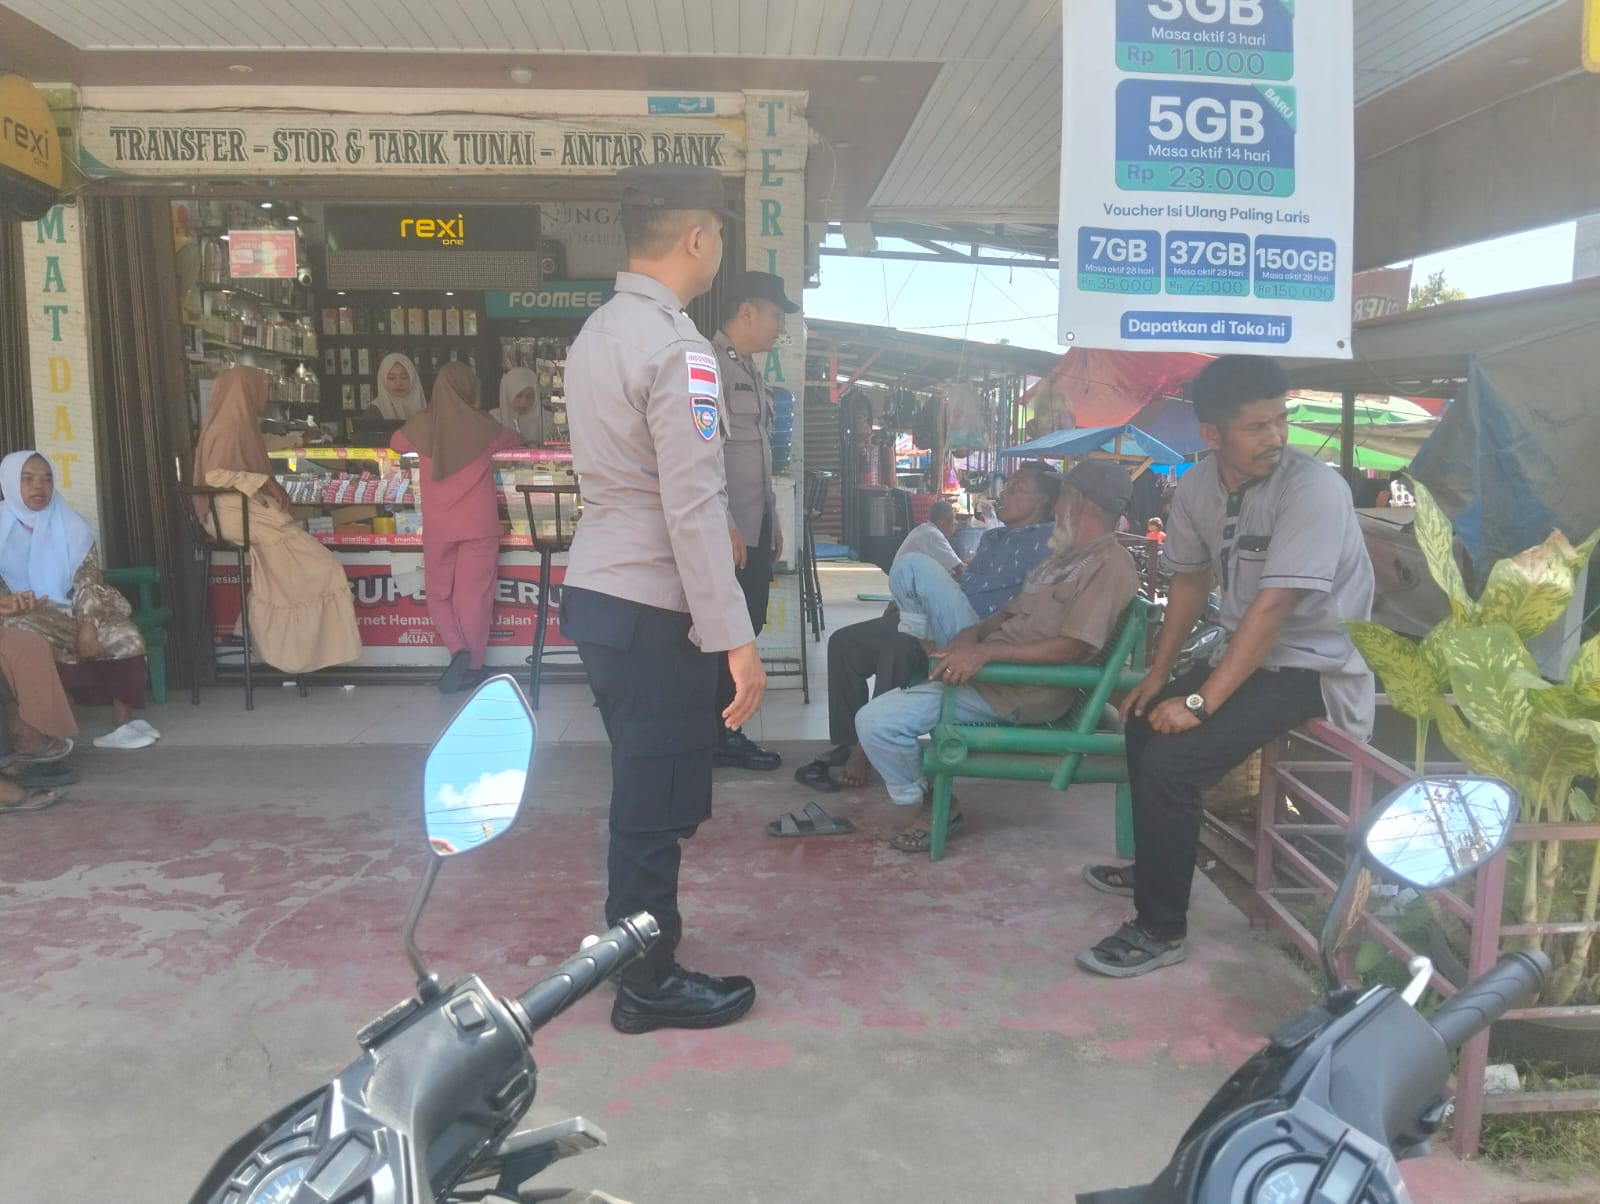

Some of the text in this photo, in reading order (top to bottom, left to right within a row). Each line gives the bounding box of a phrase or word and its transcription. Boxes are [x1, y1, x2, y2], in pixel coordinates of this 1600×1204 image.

[1151, 27, 1266, 46] Masa aktif 3 hari
[1127, 45, 1265, 75] Rp 11.000
[1264, 87, 1293, 119] BARU
[1148, 96, 1265, 145] 5GB
[3, 116, 49, 161] rexi
[110, 127, 248, 162] TRANSFER
[273, 128, 340, 164] STOR
[345, 129, 365, 164] &
[369, 129, 449, 165] TARIK
[454, 130, 536, 166] TUNAI
[561, 132, 648, 167] ANTAR
[652, 133, 727, 167] BANK
[1148, 144, 1270, 162] Masa aktif 14 hari
[1127, 164, 1275, 192] Rp 23.000
[1103, 203, 1311, 224] Voucher Isi Ulang Paling Laris
[400, 213, 464, 238] rexi
[758, 101, 785, 383] TERIA
[1089, 236, 1148, 263] 7GB
[1169, 240, 1247, 266] 37GB
[1085, 264, 1154, 275] Masa aktif 28 hari
[1255, 249, 1335, 272] 150GB
[1174, 267, 1244, 278] Masa aktif 28 hari
[1262, 271, 1283, 281] Masa
[1284, 272, 1301, 281] aktif
[1314, 273, 1329, 282] hari
[1170, 279, 1183, 291] Rp
[508, 291, 602, 309] FOOMEE
[1128, 319, 1285, 336] Dapatkan di Toko Ini
[36, 206, 77, 500] MAT DAT
[208, 573, 241, 586] pesial
[357, 615, 386, 625] rnet
[496, 613, 531, 625] Jalan
